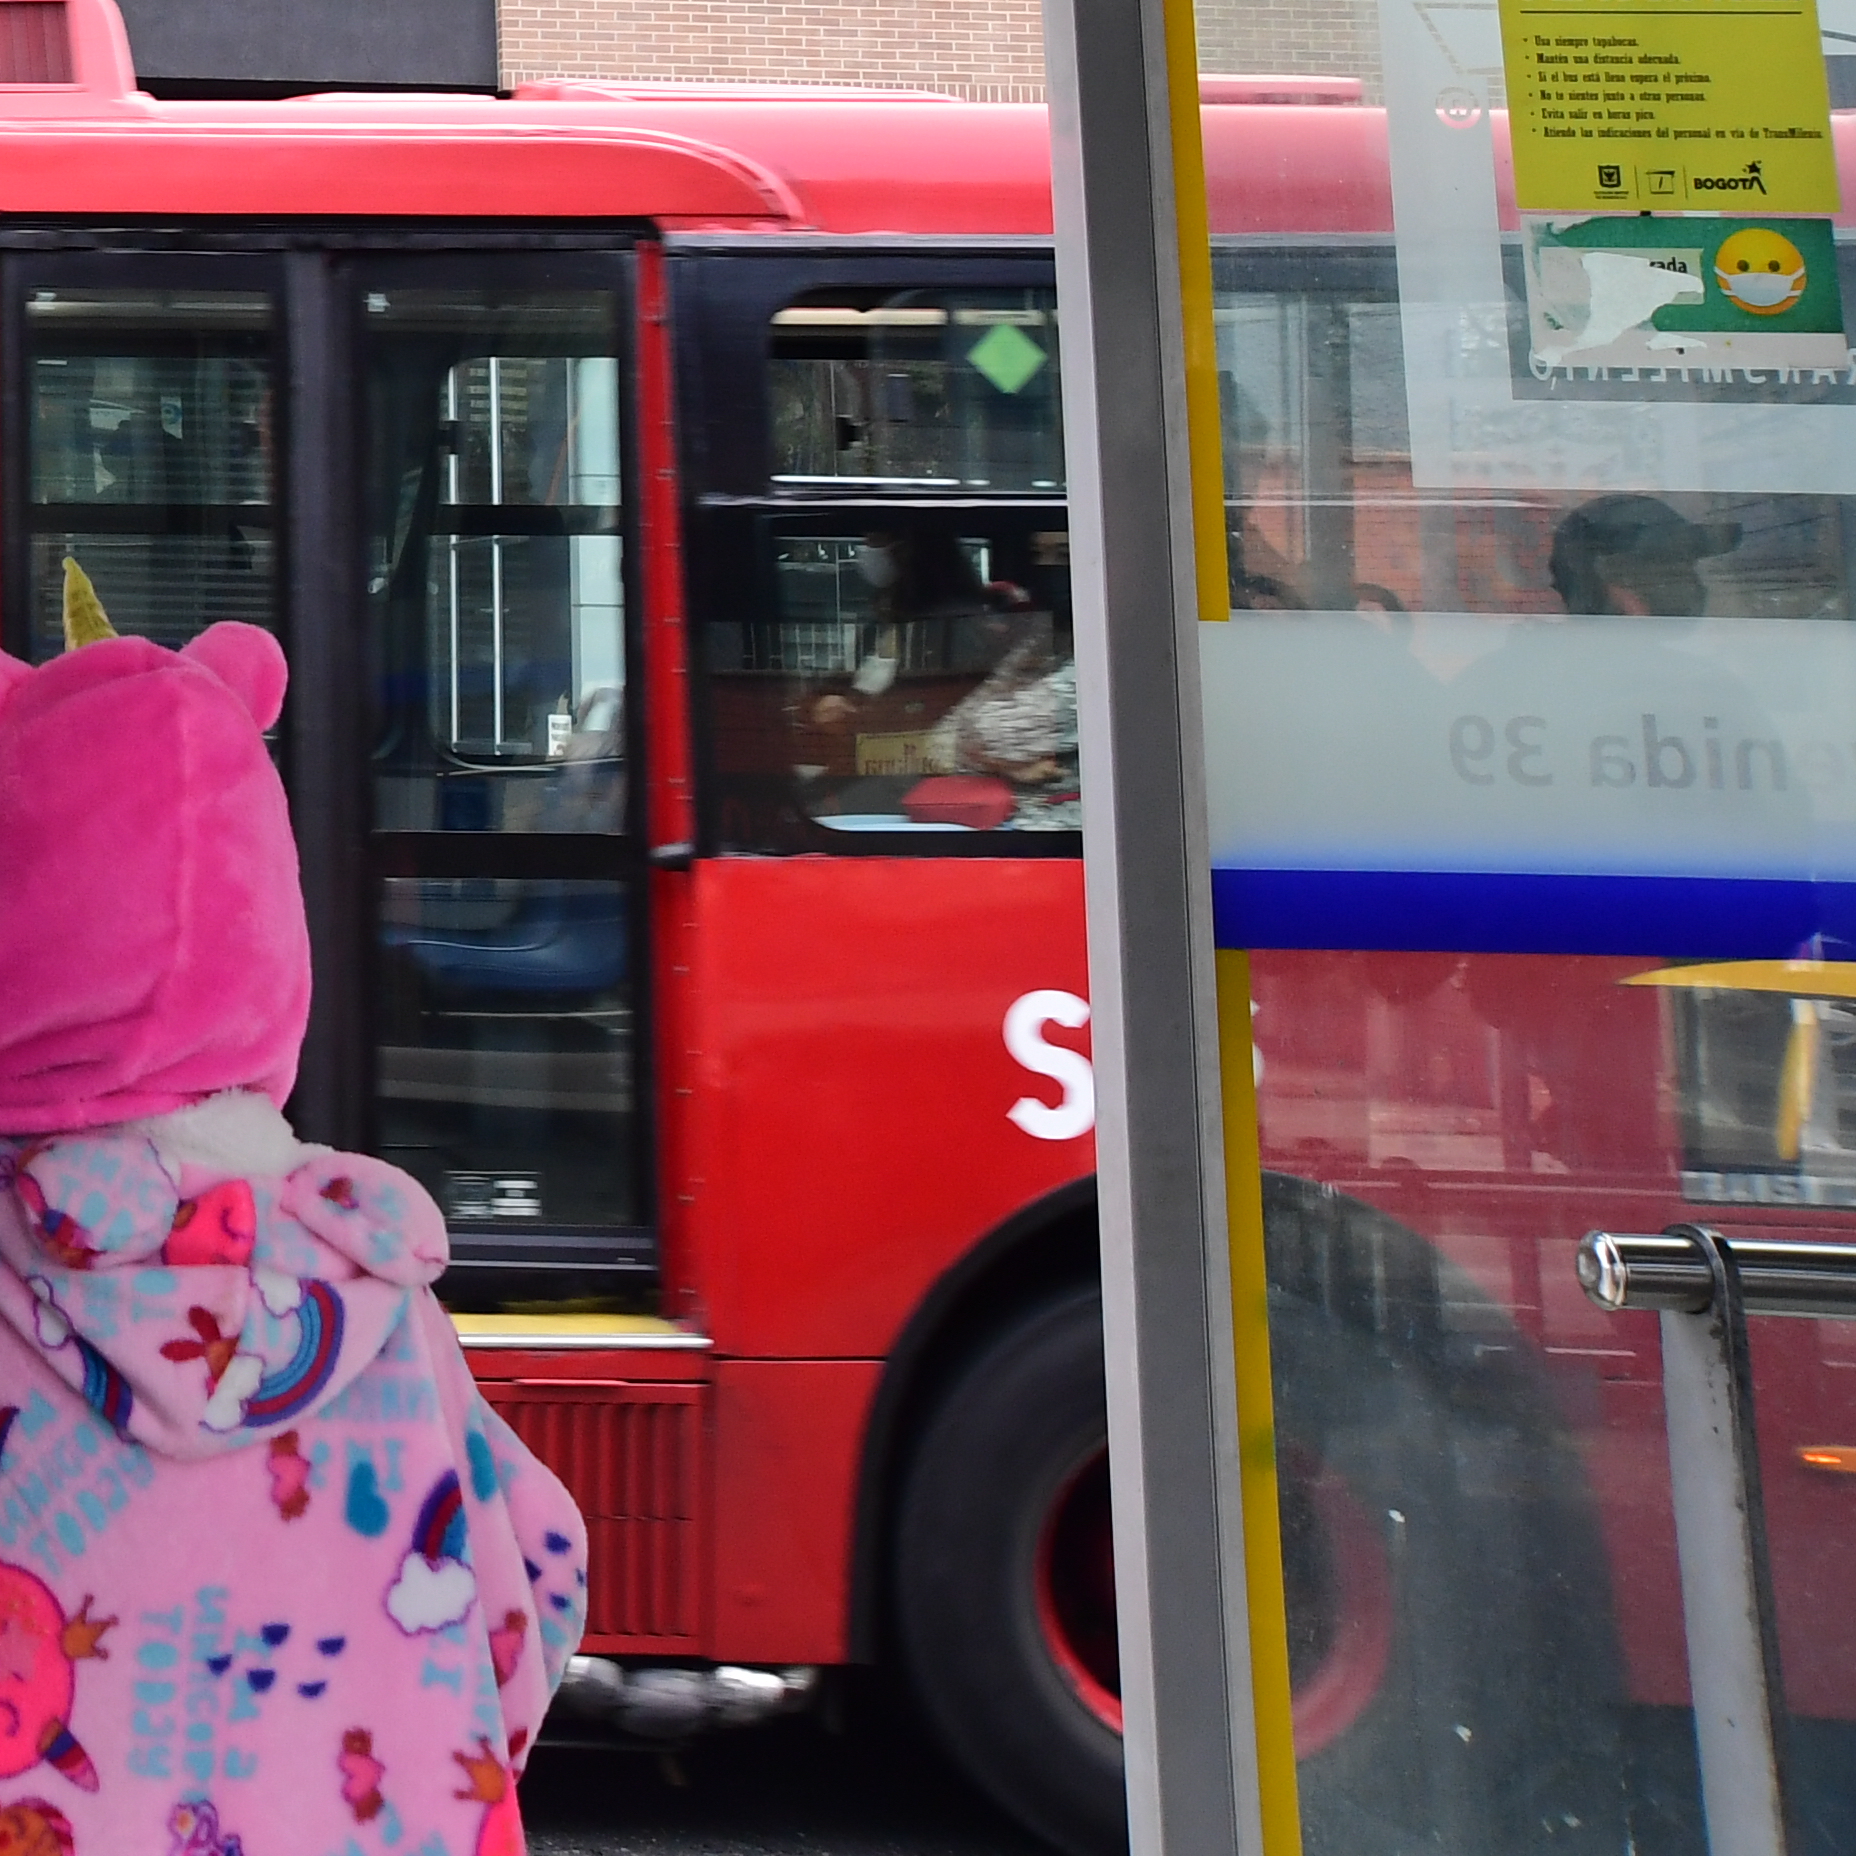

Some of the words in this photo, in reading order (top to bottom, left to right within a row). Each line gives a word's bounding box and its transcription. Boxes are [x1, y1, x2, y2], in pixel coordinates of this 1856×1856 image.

[1554, 36, 1589, 49] siempre
[1551, 71, 1559, 83] el
[1563, 71, 1578, 83] bus
[1540, 90, 1552, 101] No
[1541, 108, 1565, 120] Evita
